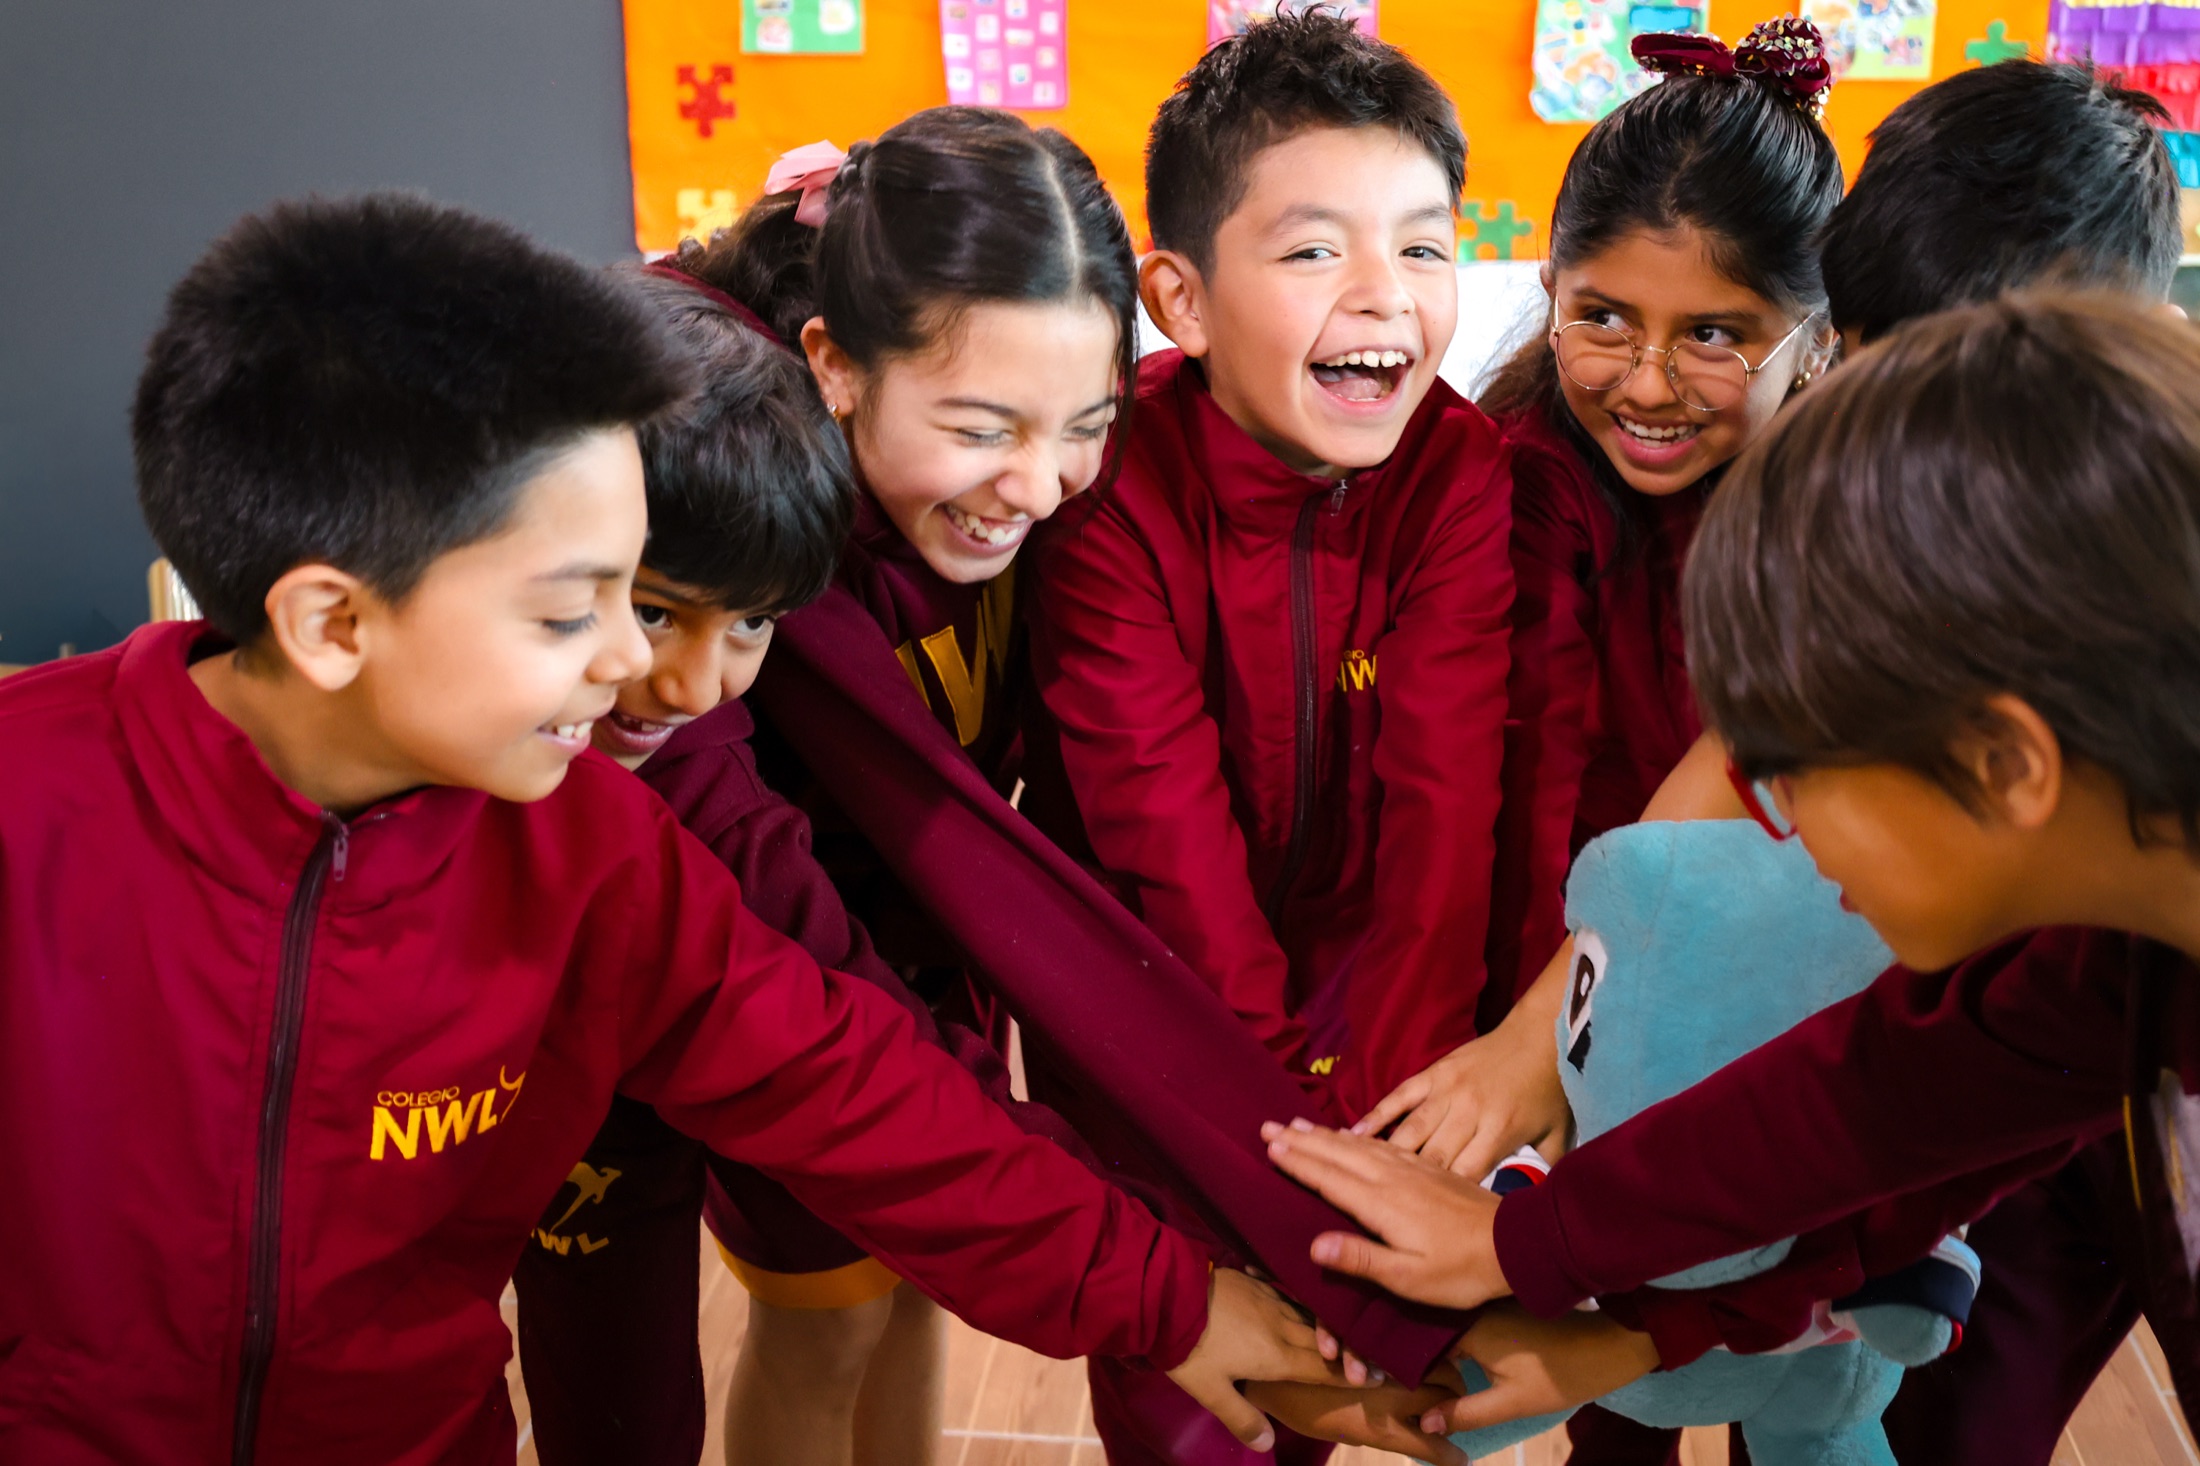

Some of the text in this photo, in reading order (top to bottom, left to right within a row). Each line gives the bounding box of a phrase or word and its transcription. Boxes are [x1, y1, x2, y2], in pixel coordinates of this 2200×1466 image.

[377, 1086, 460, 1107] COLEGIO
[370, 1088, 497, 1161] NWL
[530, 1228, 609, 1256] WL
